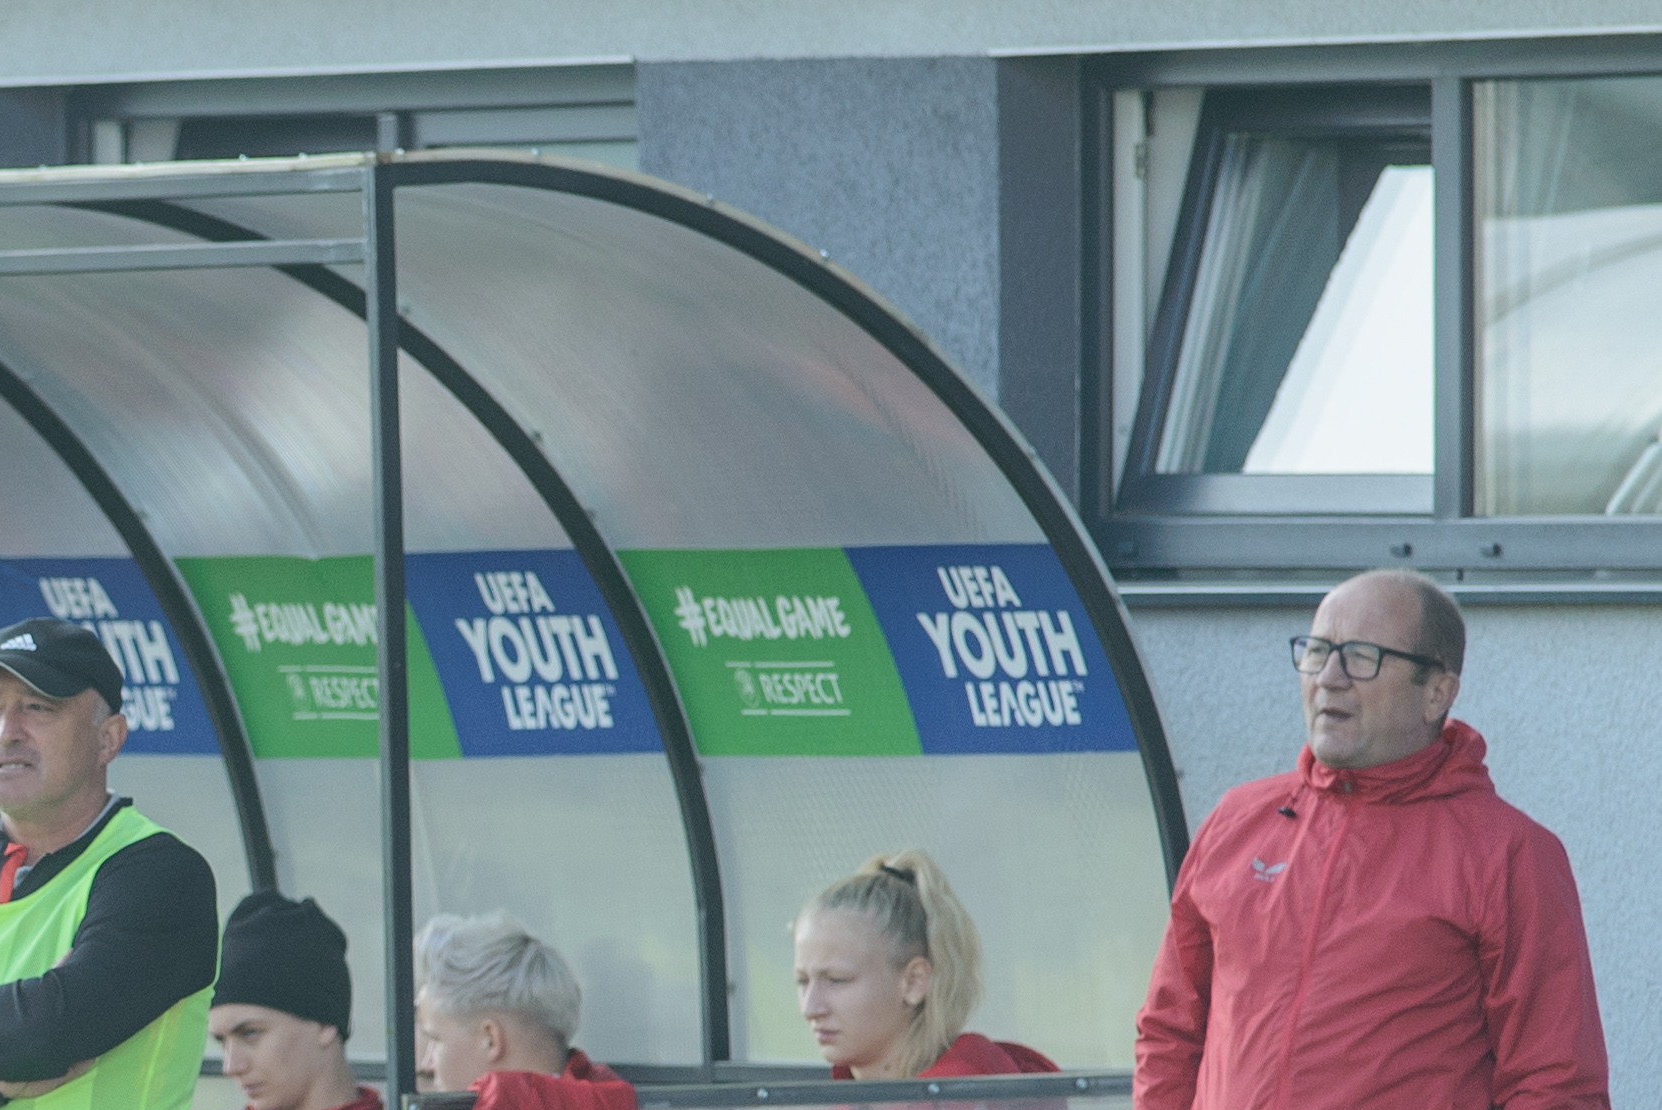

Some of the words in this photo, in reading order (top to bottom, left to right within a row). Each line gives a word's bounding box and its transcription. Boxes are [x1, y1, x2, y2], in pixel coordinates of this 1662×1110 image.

[39, 577, 119, 619] UEFA
[474, 571, 556, 614] UEFA
[938, 566, 1021, 609] UEFA
[674, 586, 851, 647] #EQUALGAME
[82, 619, 181, 685] UTH
[455, 615, 619, 684] YOUTH
[916, 611, 1089, 679] YOUTH
[501, 684, 615, 730] LEAGUE
[759, 672, 844, 704] RESPECT
[965, 681, 1082, 727] LEAGUE
